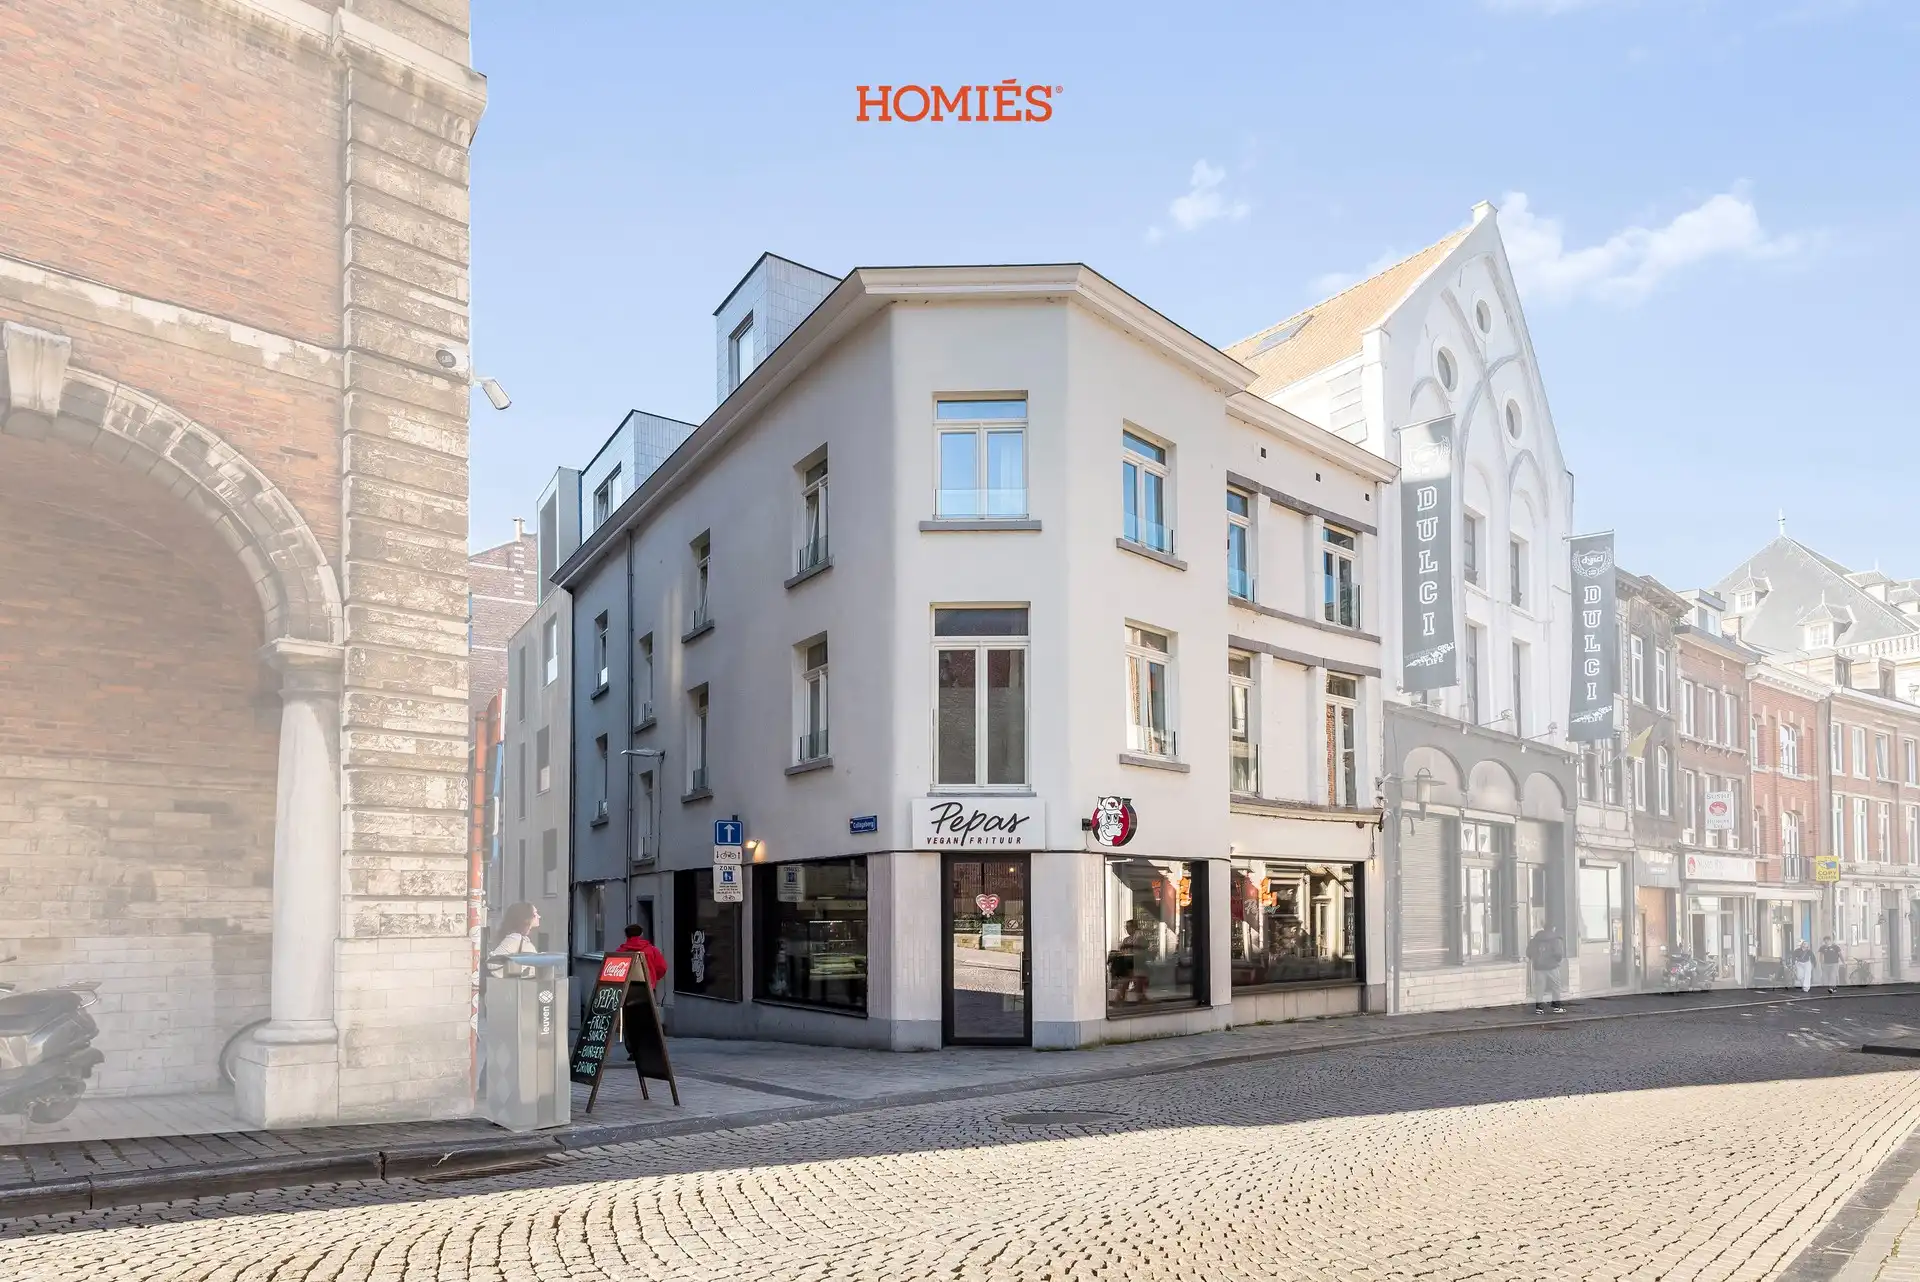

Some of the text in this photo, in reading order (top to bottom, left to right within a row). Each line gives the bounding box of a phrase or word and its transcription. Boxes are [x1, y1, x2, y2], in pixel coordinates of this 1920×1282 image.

[1416, 485, 1438, 636] DULCI
[1583, 585, 1602, 700] DULCI
[926, 836, 1022, 845] VEGAN FRITUUR
[930, 801, 1030, 846] Pepas
[540, 1005, 550, 1035] leuven
